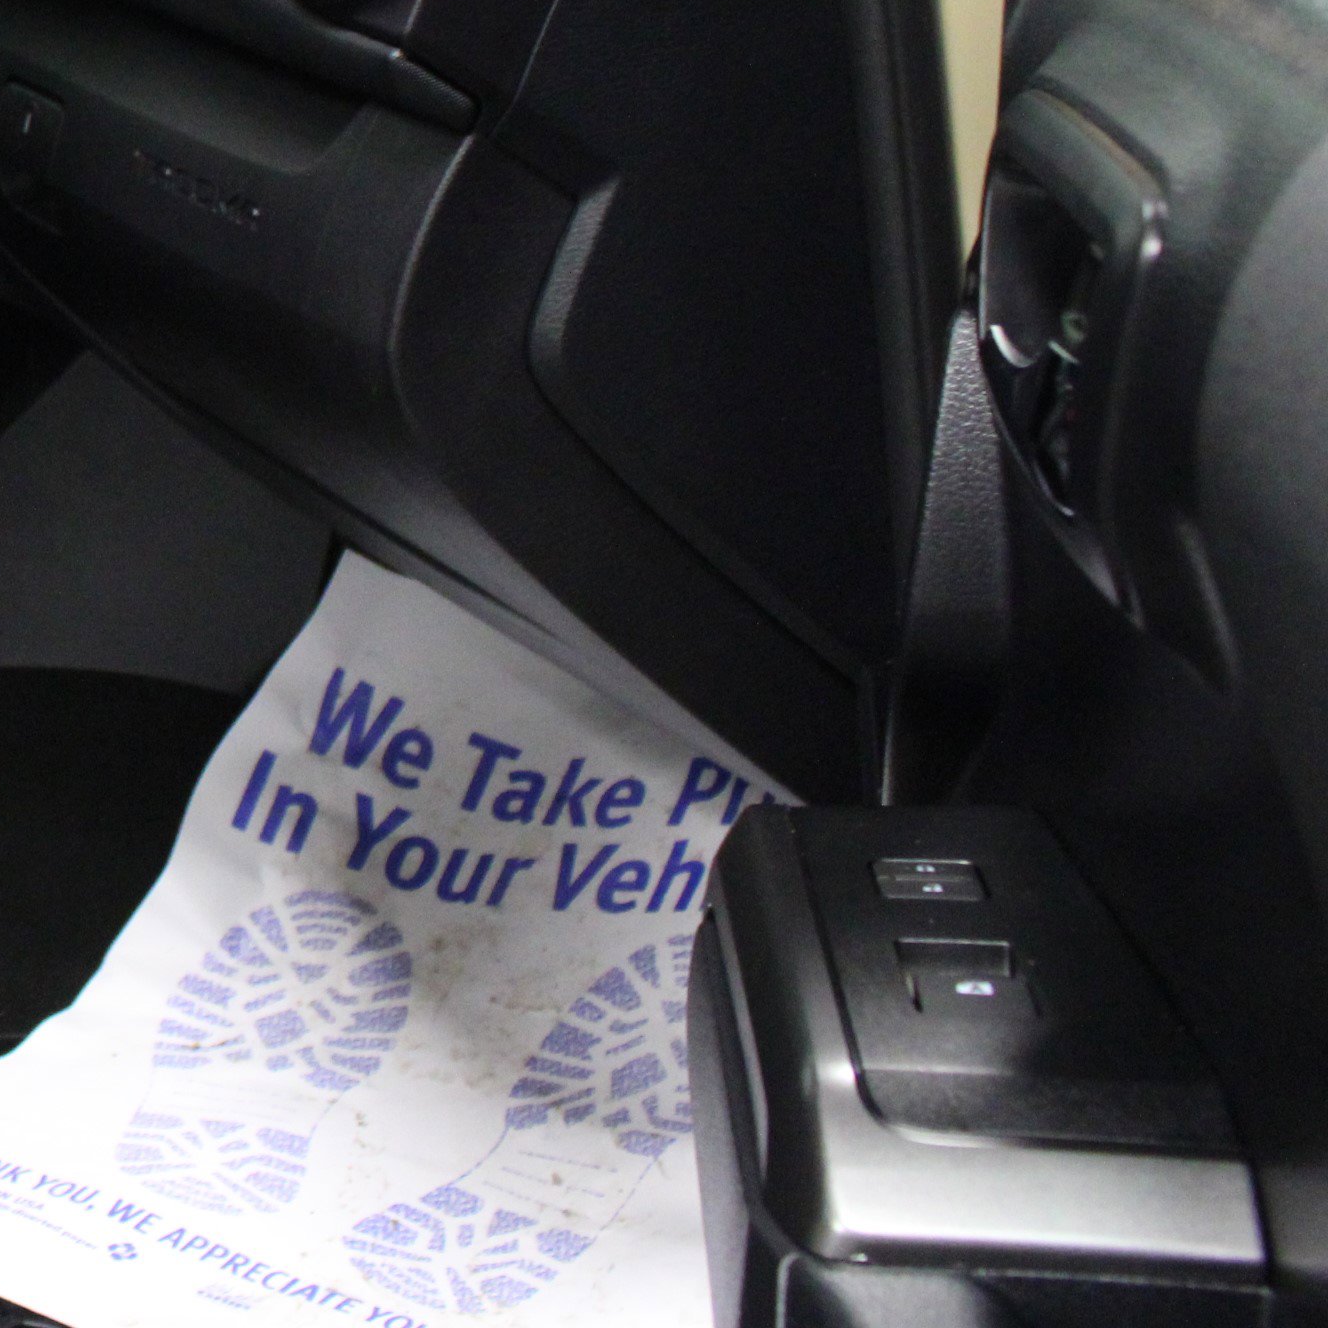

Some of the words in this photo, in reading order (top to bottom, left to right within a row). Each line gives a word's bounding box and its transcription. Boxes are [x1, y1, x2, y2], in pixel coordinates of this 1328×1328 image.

[309, 668, 434, 788] We
[460, 732, 645, 828] Take
[231, 750, 318, 854] In
[345, 792, 537, 910] Your
[553, 838, 706, 914] Veh
[13, 1196, 45, 1211] USA
[32, 1174, 101, 1211] YOU,
[107, 1198, 163, 1234] WE
[158, 1227, 364, 1314] APPRECIATE
